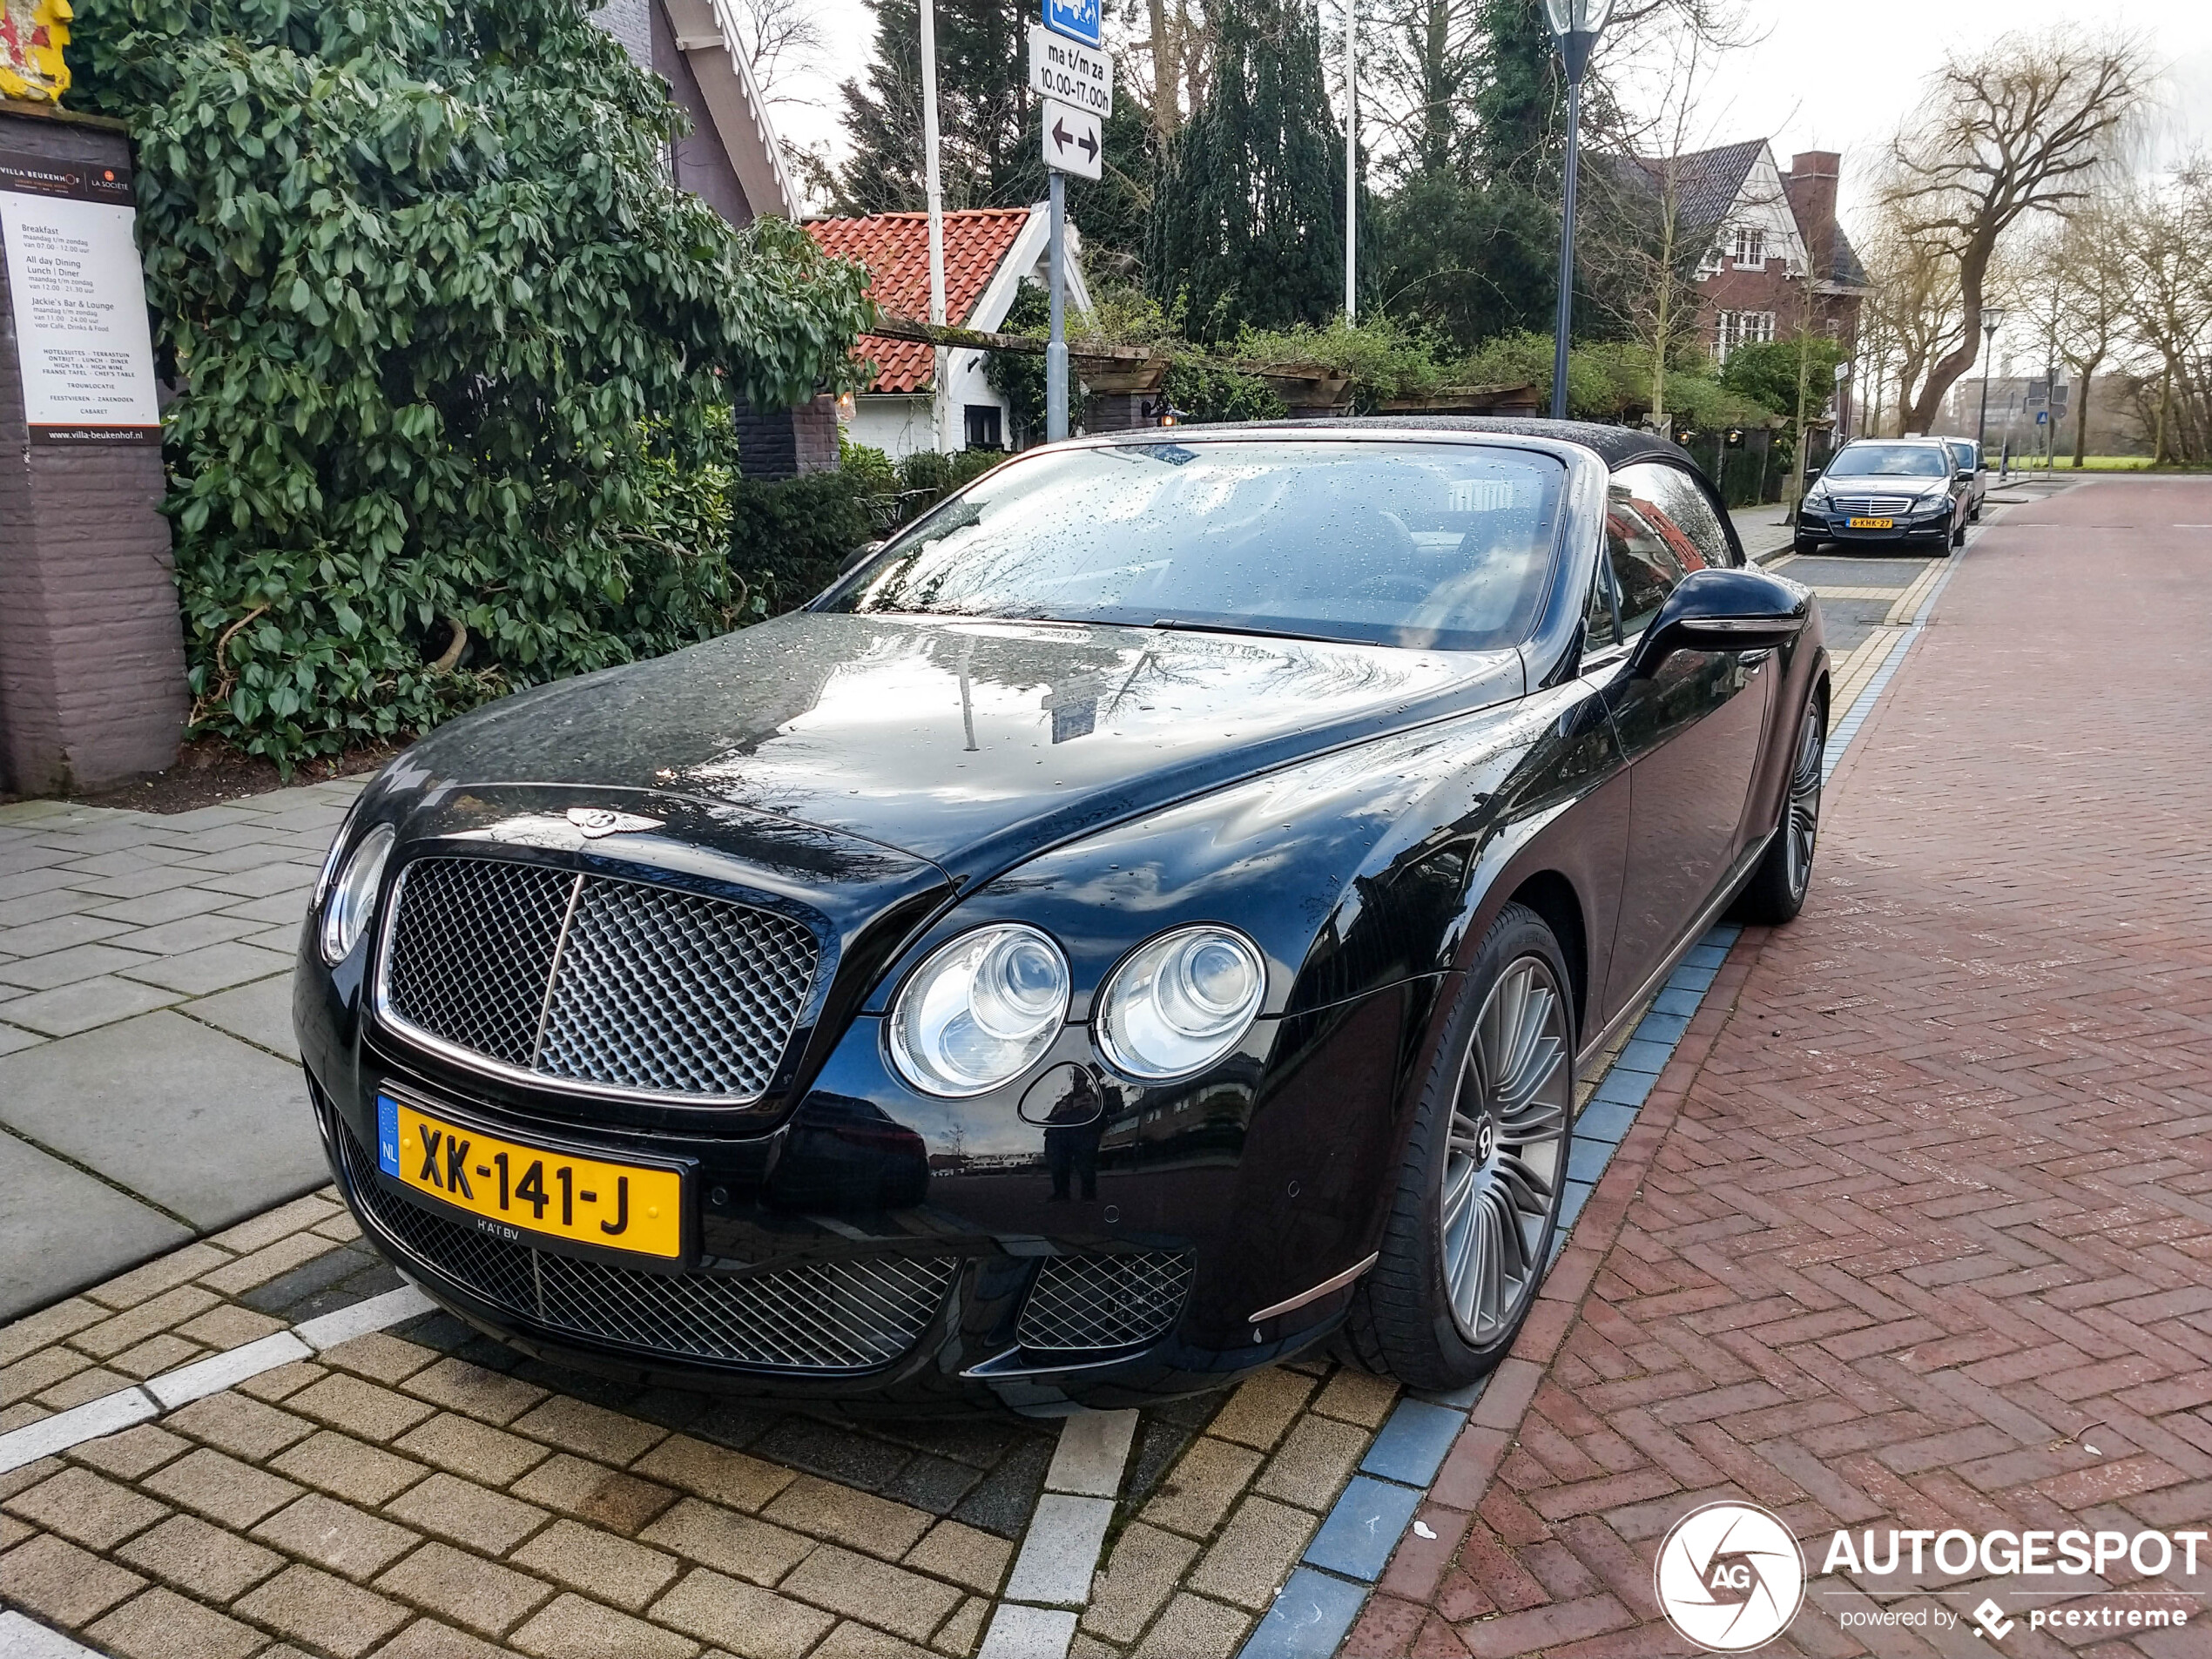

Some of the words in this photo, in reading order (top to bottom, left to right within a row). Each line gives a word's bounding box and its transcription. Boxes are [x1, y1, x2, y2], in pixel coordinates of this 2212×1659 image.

[1049, 44, 1064, 65] ma
[1069, 49, 1089, 75] t/m
[1092, 62, 1103, 80] za
[1041, 66, 1109, 111] 10.00-17.00h
[0, 166, 24, 176] VILLA
[27, 171, 80, 185] BEUKENHOF
[22, 224, 58, 234] Breakfast
[24, 234, 51, 243] maandag
[39, 257, 52, 266] day
[56, 258, 80, 268] Dining
[58, 268, 79, 277] Diner
[87, 301, 114, 311] Lounge
[49, 430, 143, 439] www.villa-beukenhof.nl
[381, 1141, 397, 1163] NL
[419, 1123, 629, 1237] XK-141-J
[503, 1228, 519, 1240] BV
